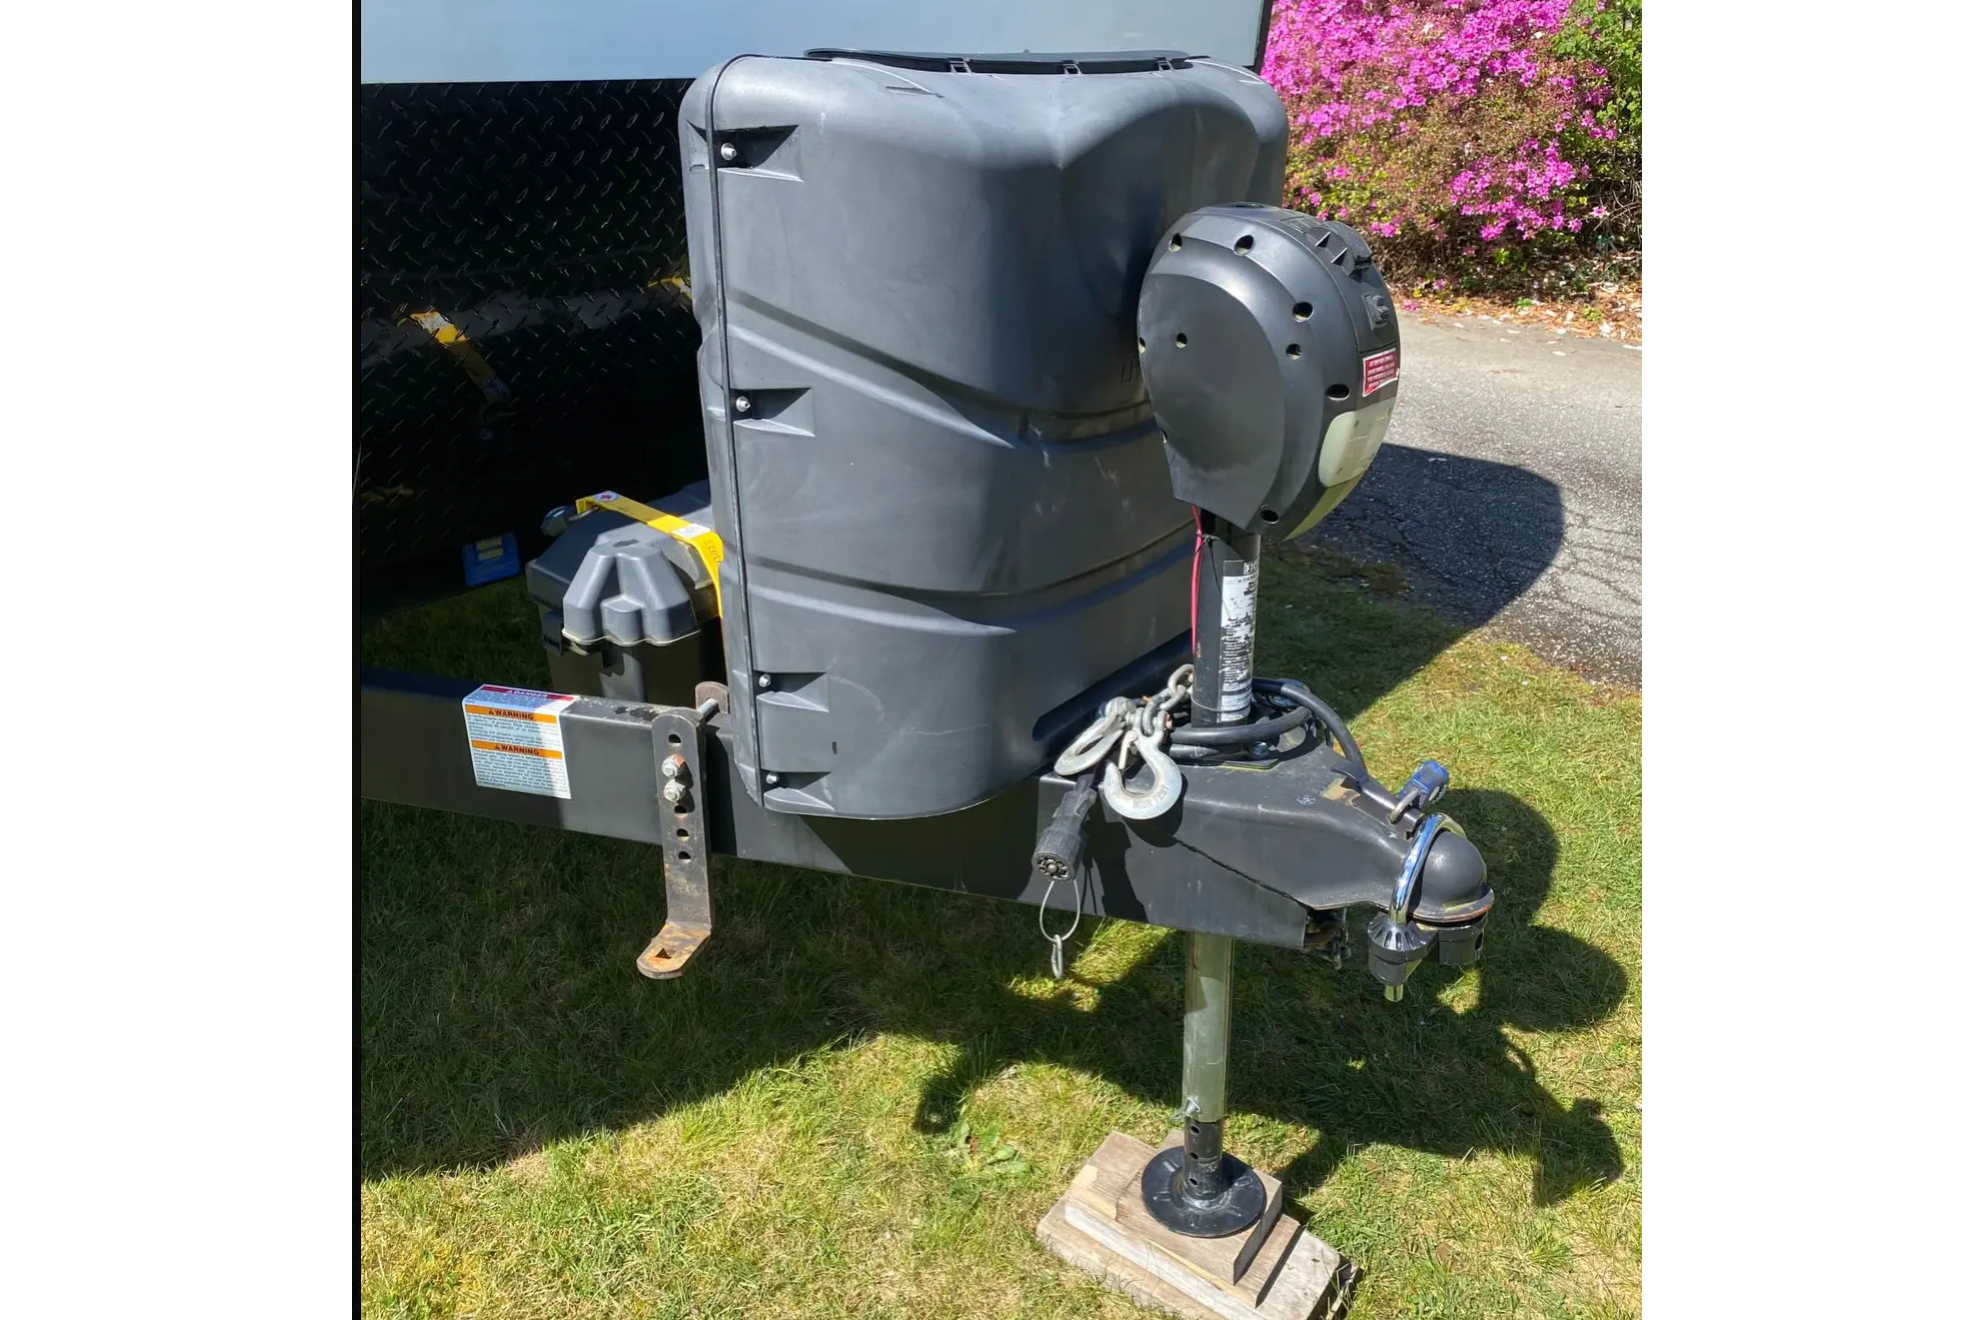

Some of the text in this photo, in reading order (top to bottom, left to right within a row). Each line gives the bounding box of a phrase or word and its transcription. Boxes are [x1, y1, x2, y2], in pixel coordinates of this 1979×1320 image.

[513, 690, 548, 698] DANGER
[495, 709, 534, 720] WARNING
[501, 745, 540, 756] WARNING
